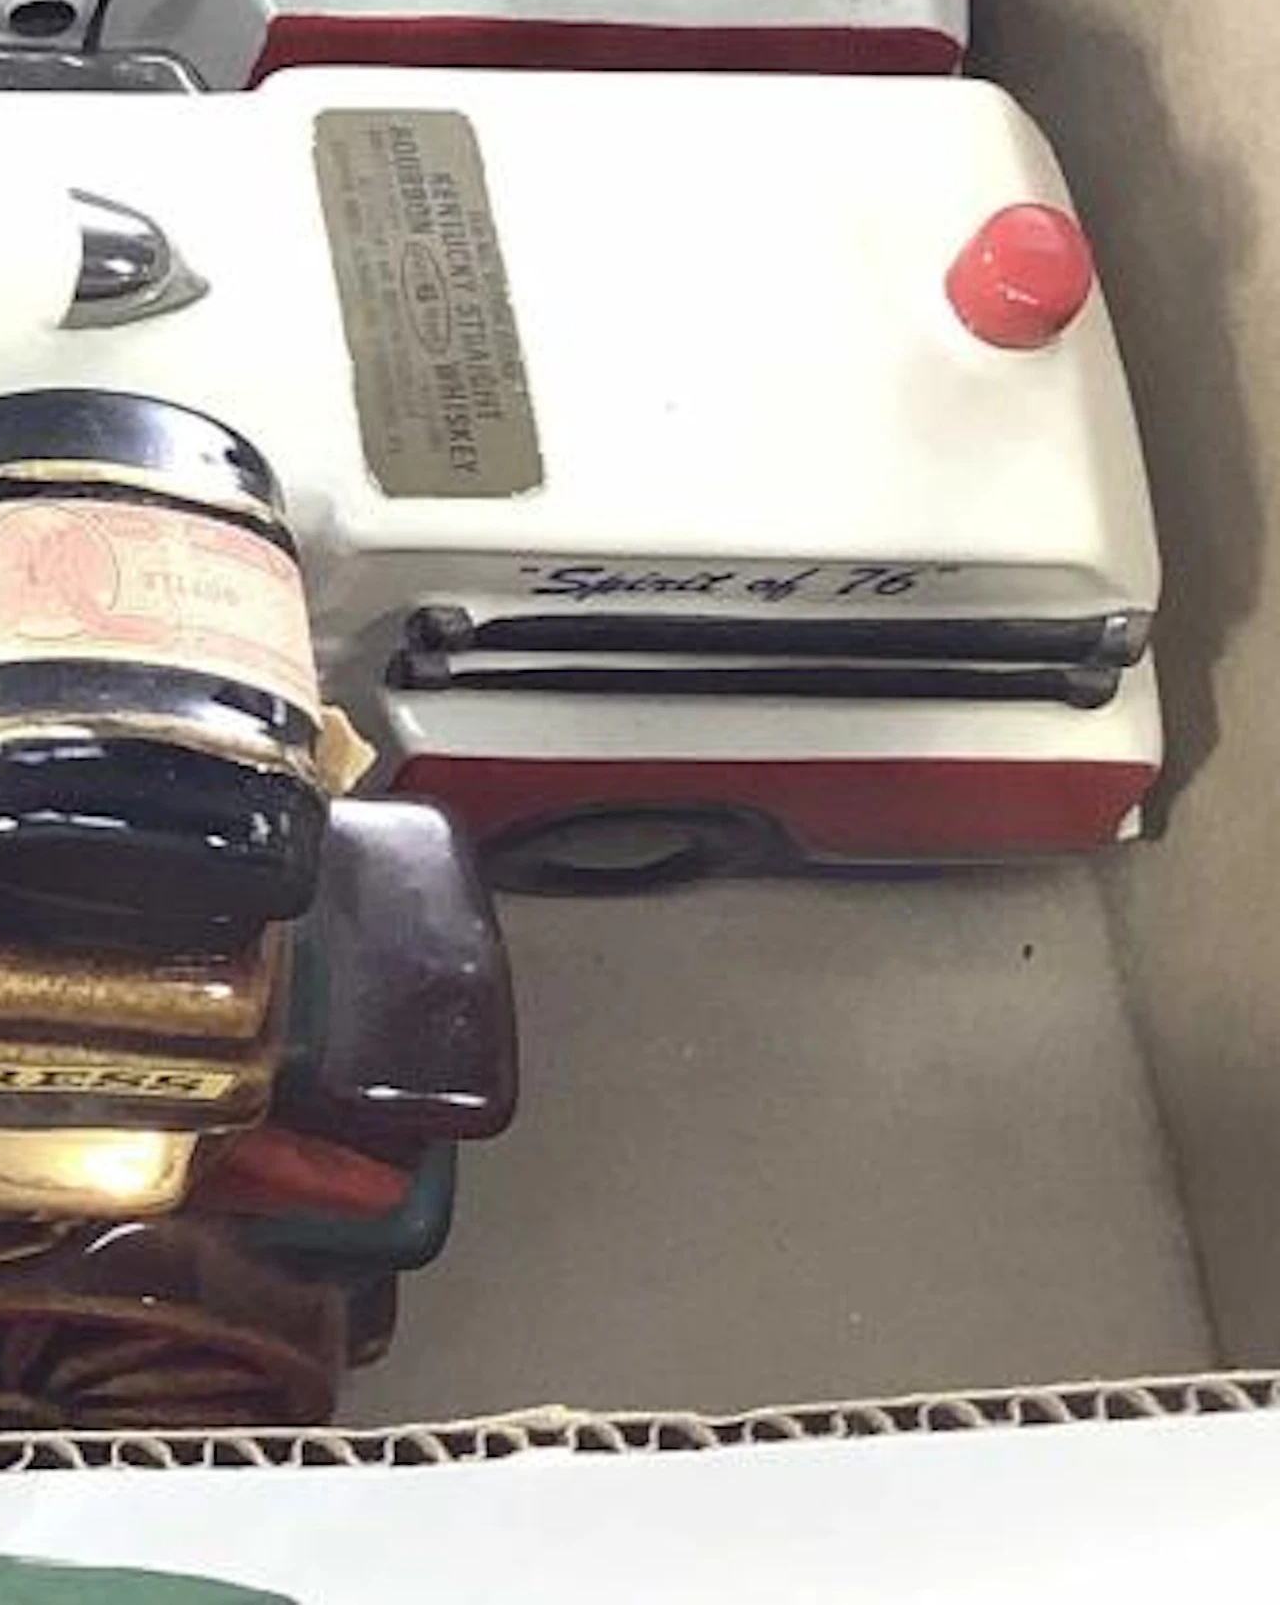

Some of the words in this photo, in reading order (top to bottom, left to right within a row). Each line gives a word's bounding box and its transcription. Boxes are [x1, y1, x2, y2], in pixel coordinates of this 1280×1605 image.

[426, 171, 477, 292] KENTUCKY
[454, 302, 503, 422] STRAIGHT
[434, 363, 483, 476] WHISKEY
[745, 567, 821, 602] of
